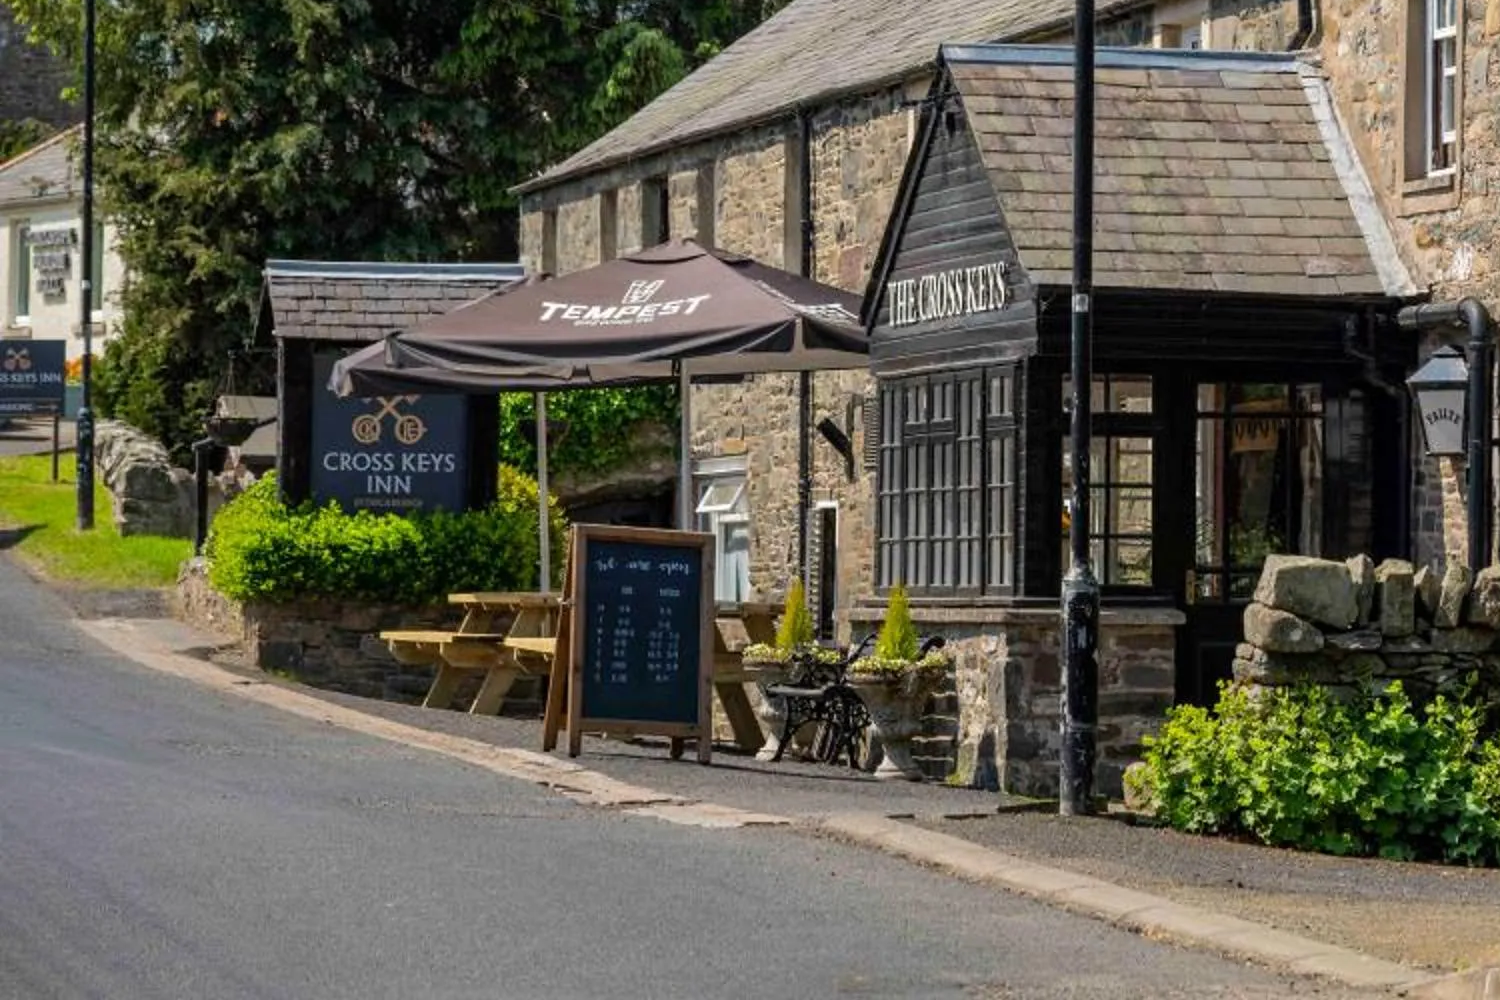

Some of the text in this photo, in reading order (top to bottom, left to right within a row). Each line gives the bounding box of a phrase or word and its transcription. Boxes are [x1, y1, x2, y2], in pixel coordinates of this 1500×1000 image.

[888, 279, 916, 327] THE
[918, 268, 963, 321] CROSS
[965, 261, 1007, 314] KEYS
[539, 293, 712, 322] TEMPEST
[323, 451, 456, 473] CROSS KEYS
[367, 475, 412, 494] INN
